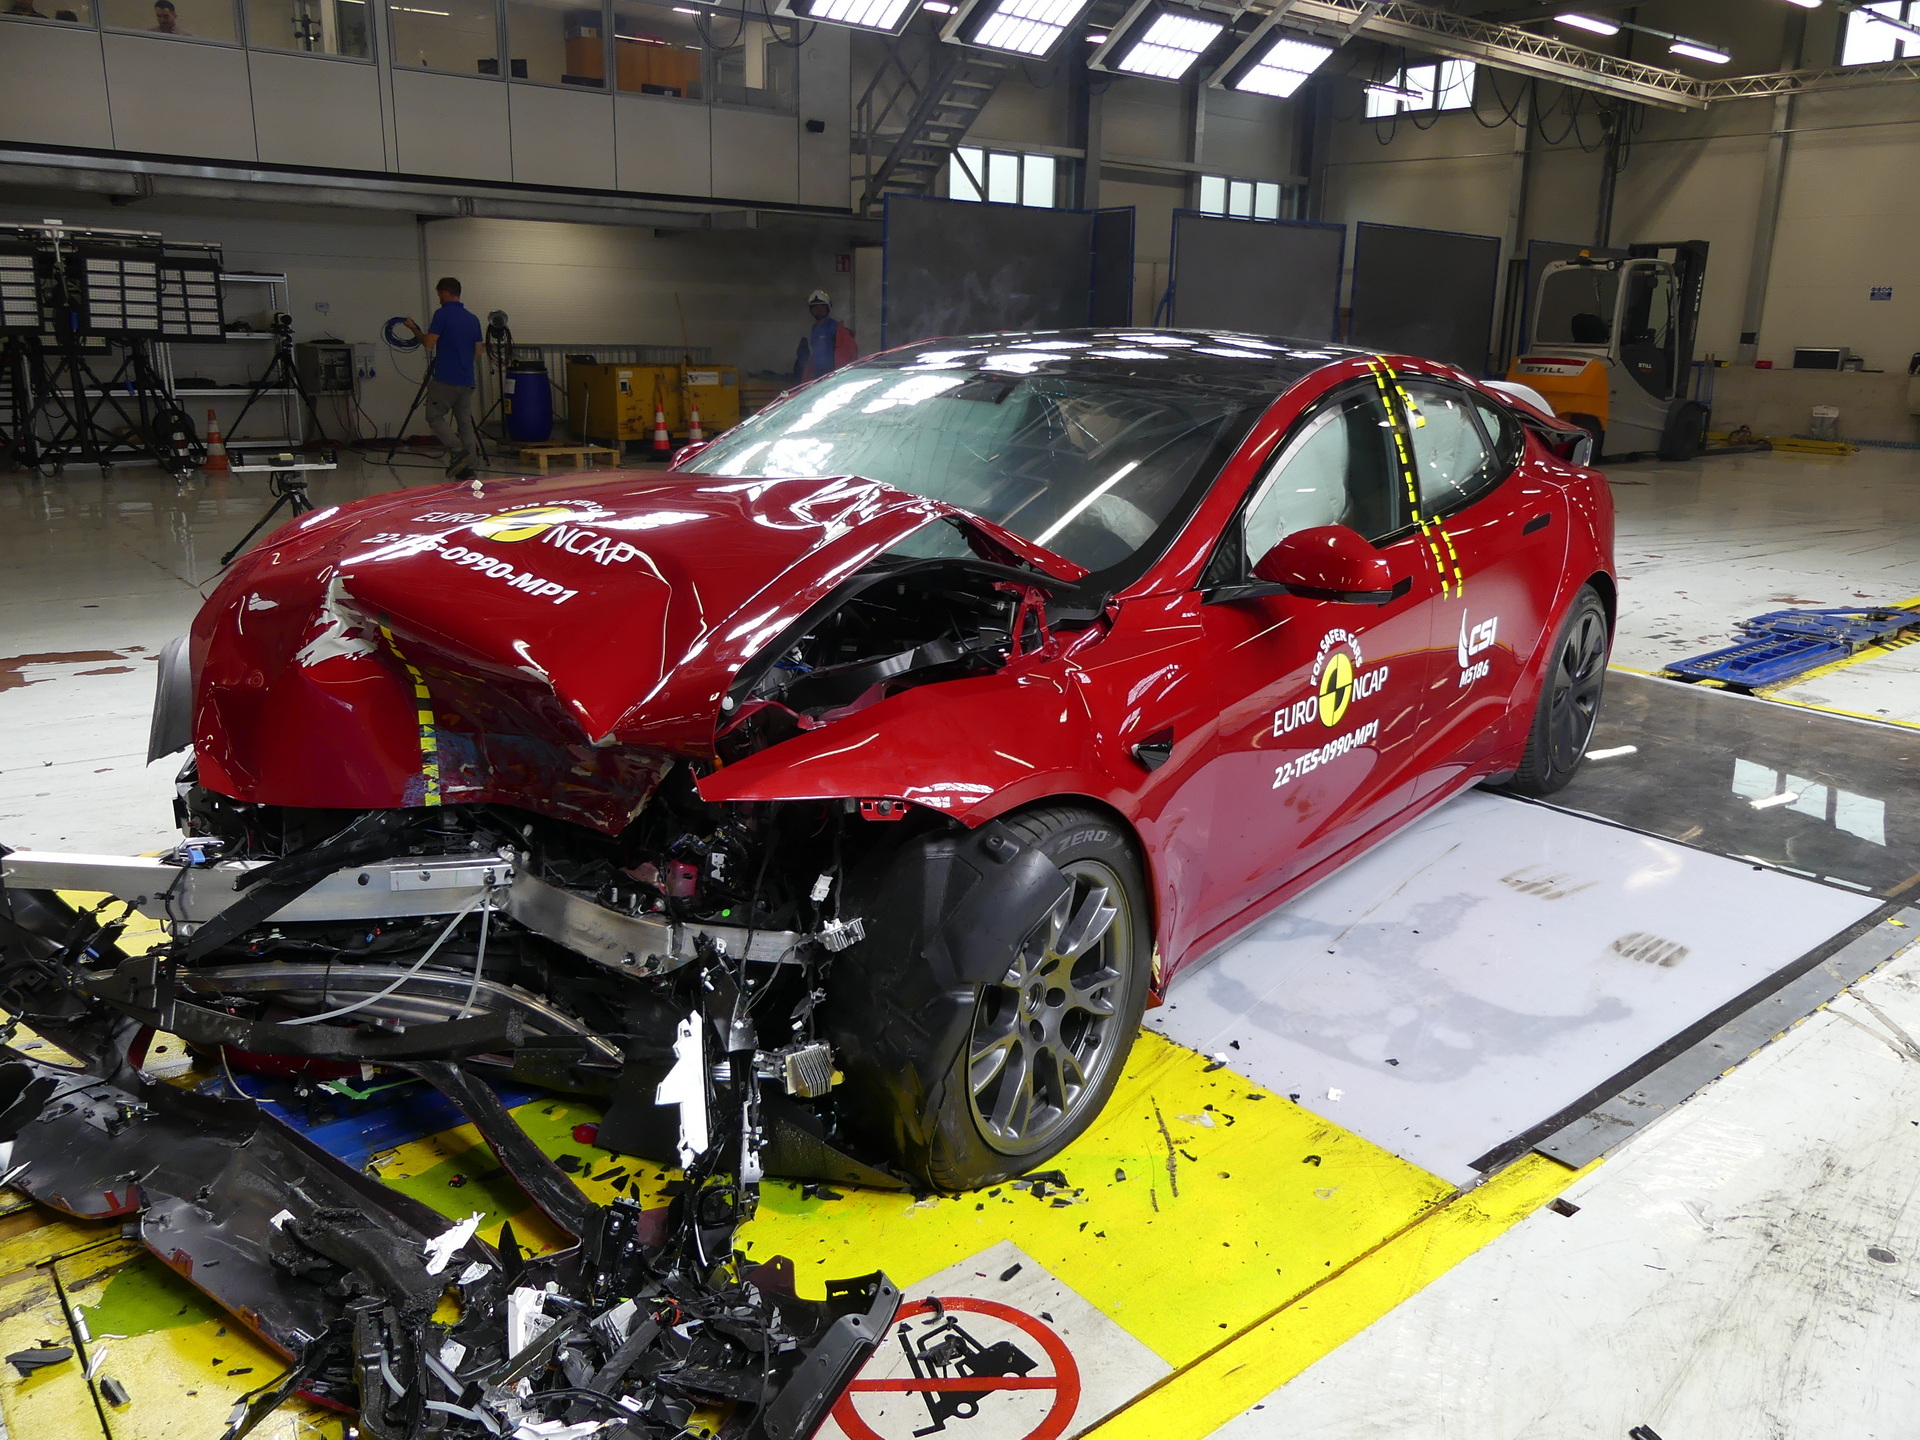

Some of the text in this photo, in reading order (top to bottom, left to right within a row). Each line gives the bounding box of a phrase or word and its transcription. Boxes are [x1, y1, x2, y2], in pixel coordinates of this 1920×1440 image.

[1525, 366, 1565, 375] STILL
[1638, 362, 1652, 370] STILL
[498, 502, 540, 512] FOR
[411, 511, 636, 566] EURO NCAP
[1468, 616, 1498, 655] CSI
[1310, 628, 1363, 686] FOR SAFER CARS
[1459, 659, 1490, 688] M5186
[1273, 665, 1389, 738] EURO NCAP
[1272, 718, 1380, 790] 22-TES-0990-MP1
[1056, 829, 1108, 855] ZERO
